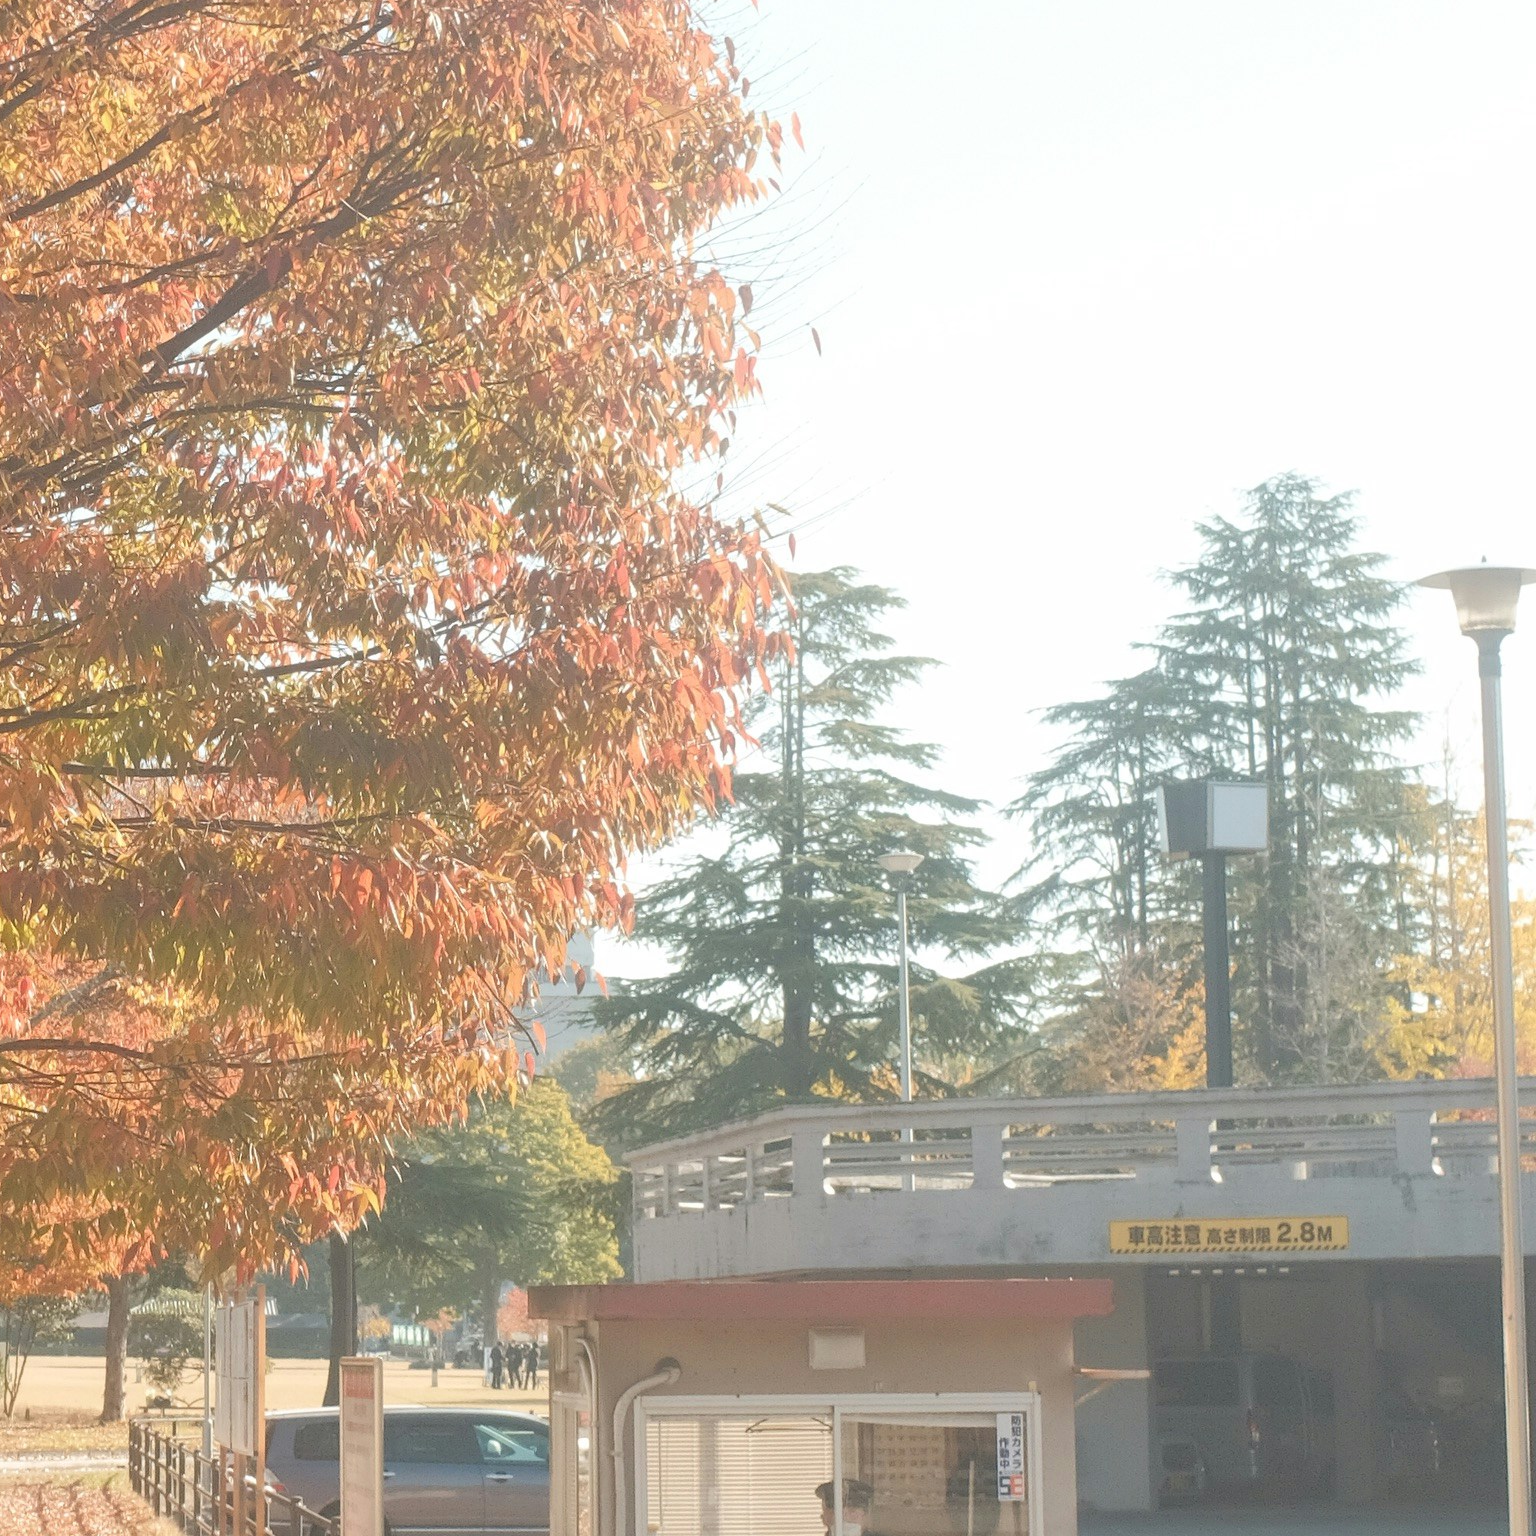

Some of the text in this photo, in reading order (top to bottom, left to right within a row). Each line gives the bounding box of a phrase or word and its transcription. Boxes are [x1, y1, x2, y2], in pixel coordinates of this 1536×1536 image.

[1128, 1221, 1333, 1246] 車高注意 高さ制限 2.8M
[999, 1437, 1010, 1469] 作動中
[1011, 1415, 1021, 1469] 防犯カメラ
